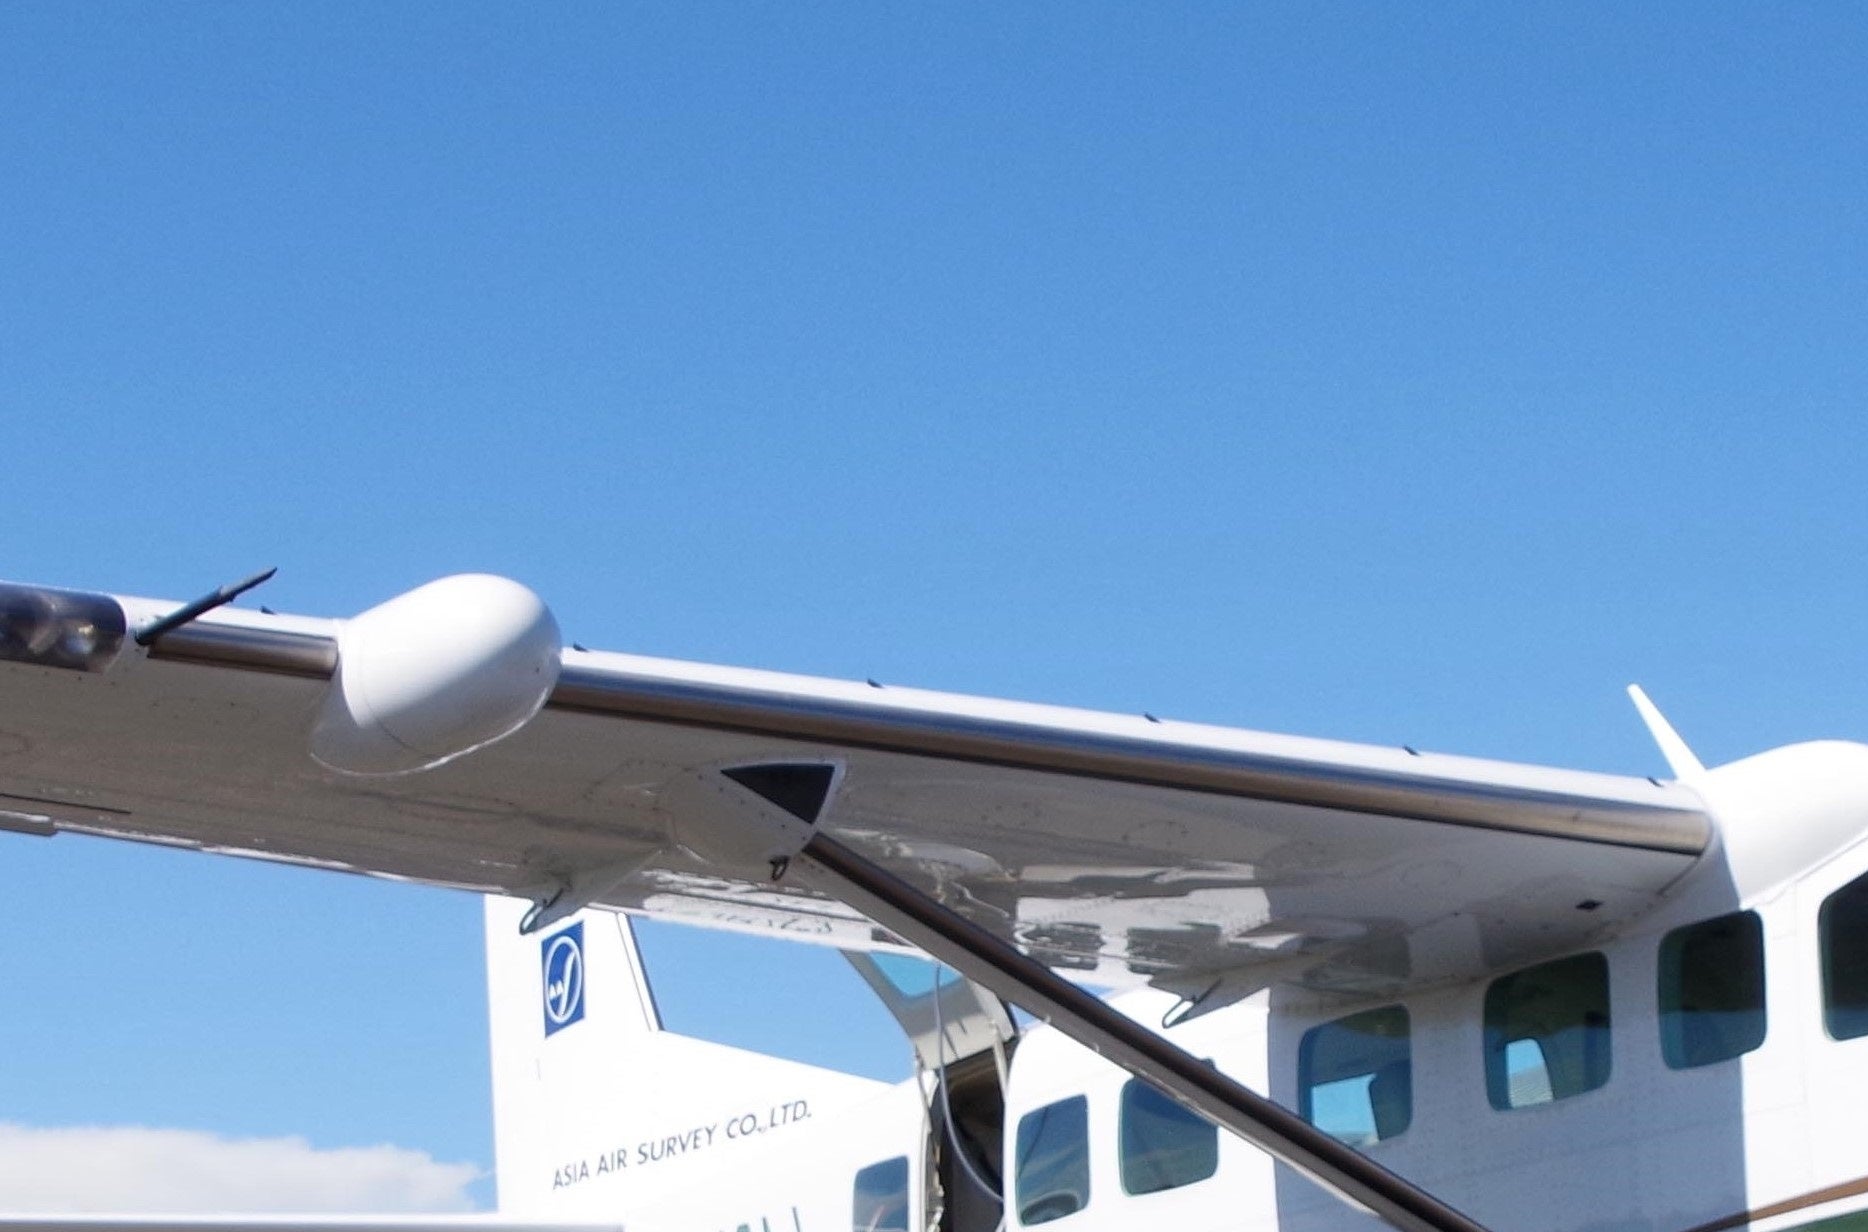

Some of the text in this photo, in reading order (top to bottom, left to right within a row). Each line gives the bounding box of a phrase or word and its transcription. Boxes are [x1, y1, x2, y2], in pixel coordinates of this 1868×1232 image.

[553, 1160, 590, 1190] ASIA
[597, 1148, 628, 1176] AIR
[637, 1123, 718, 1166] SURVEY
